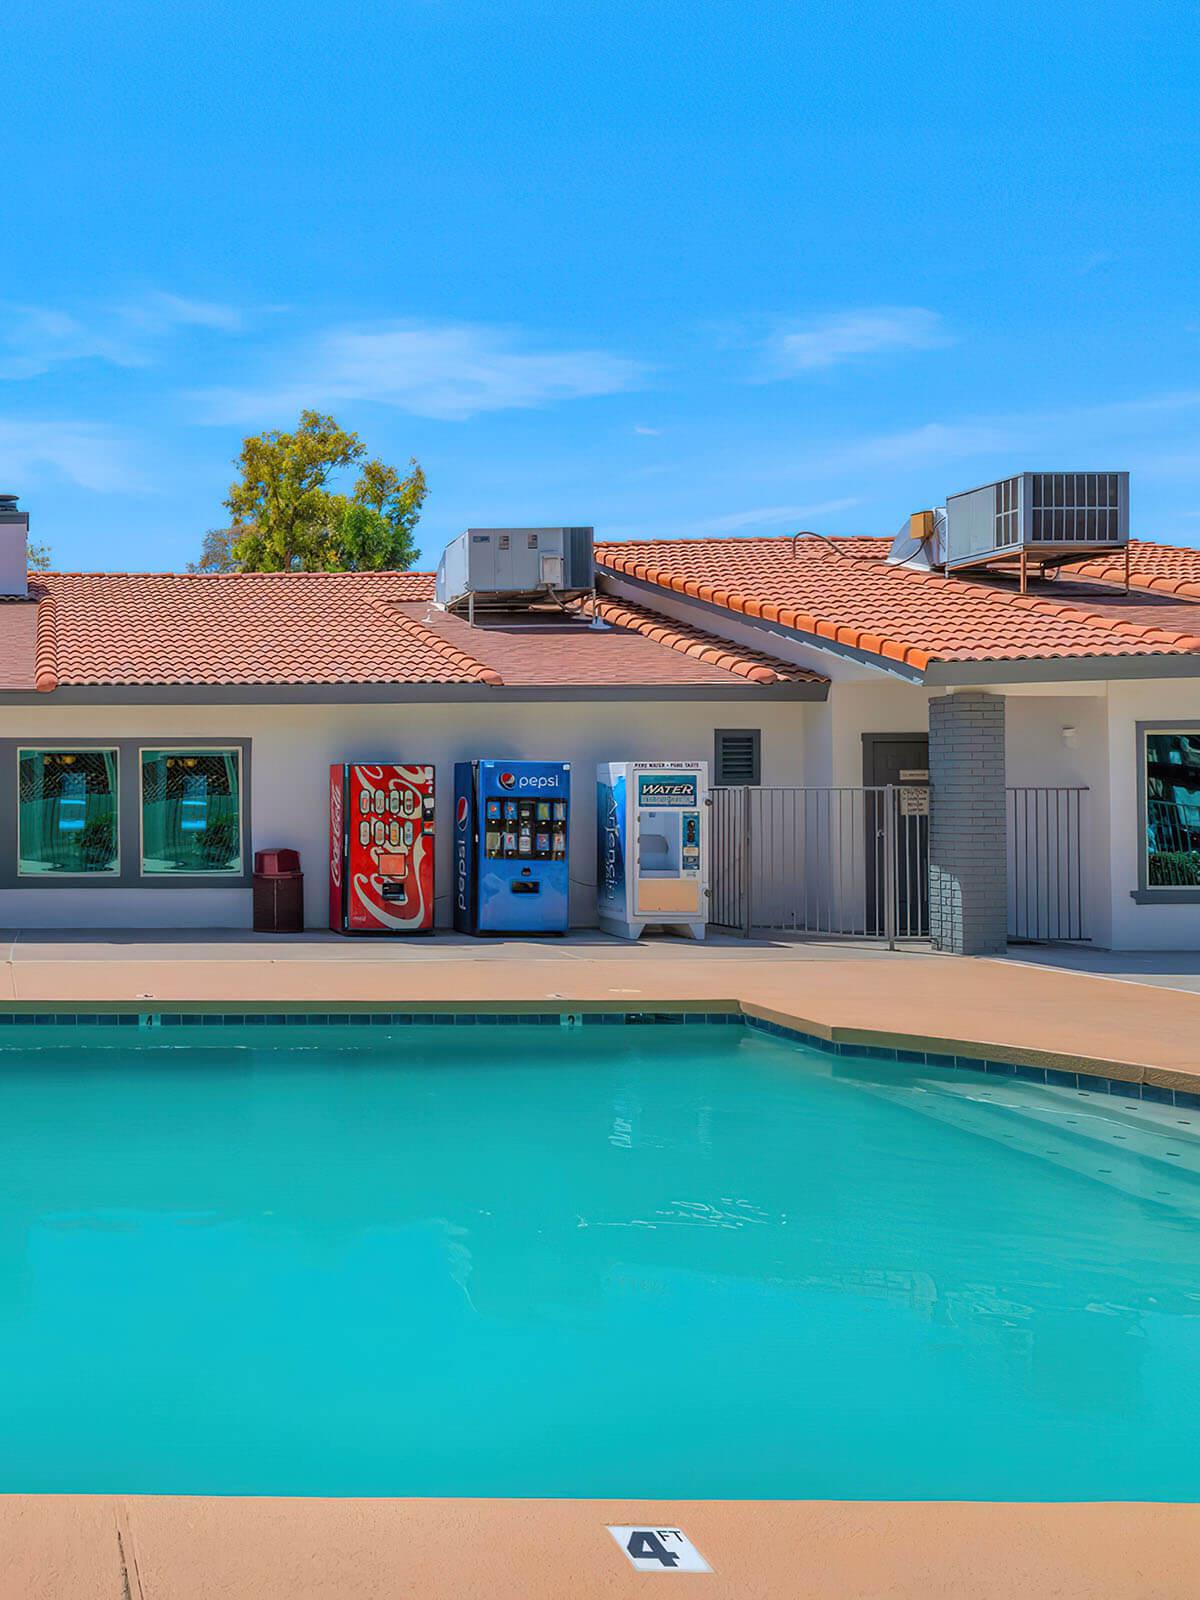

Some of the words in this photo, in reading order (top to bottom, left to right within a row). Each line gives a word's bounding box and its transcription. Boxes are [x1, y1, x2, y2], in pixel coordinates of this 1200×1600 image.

[519, 775, 559, 788] pepsi
[642, 783, 694, 795] WATER
[458, 840, 467, 910] pepsi
[626, 1531, 680, 1567] 4
[656, 1530, 684, 1542] FT
